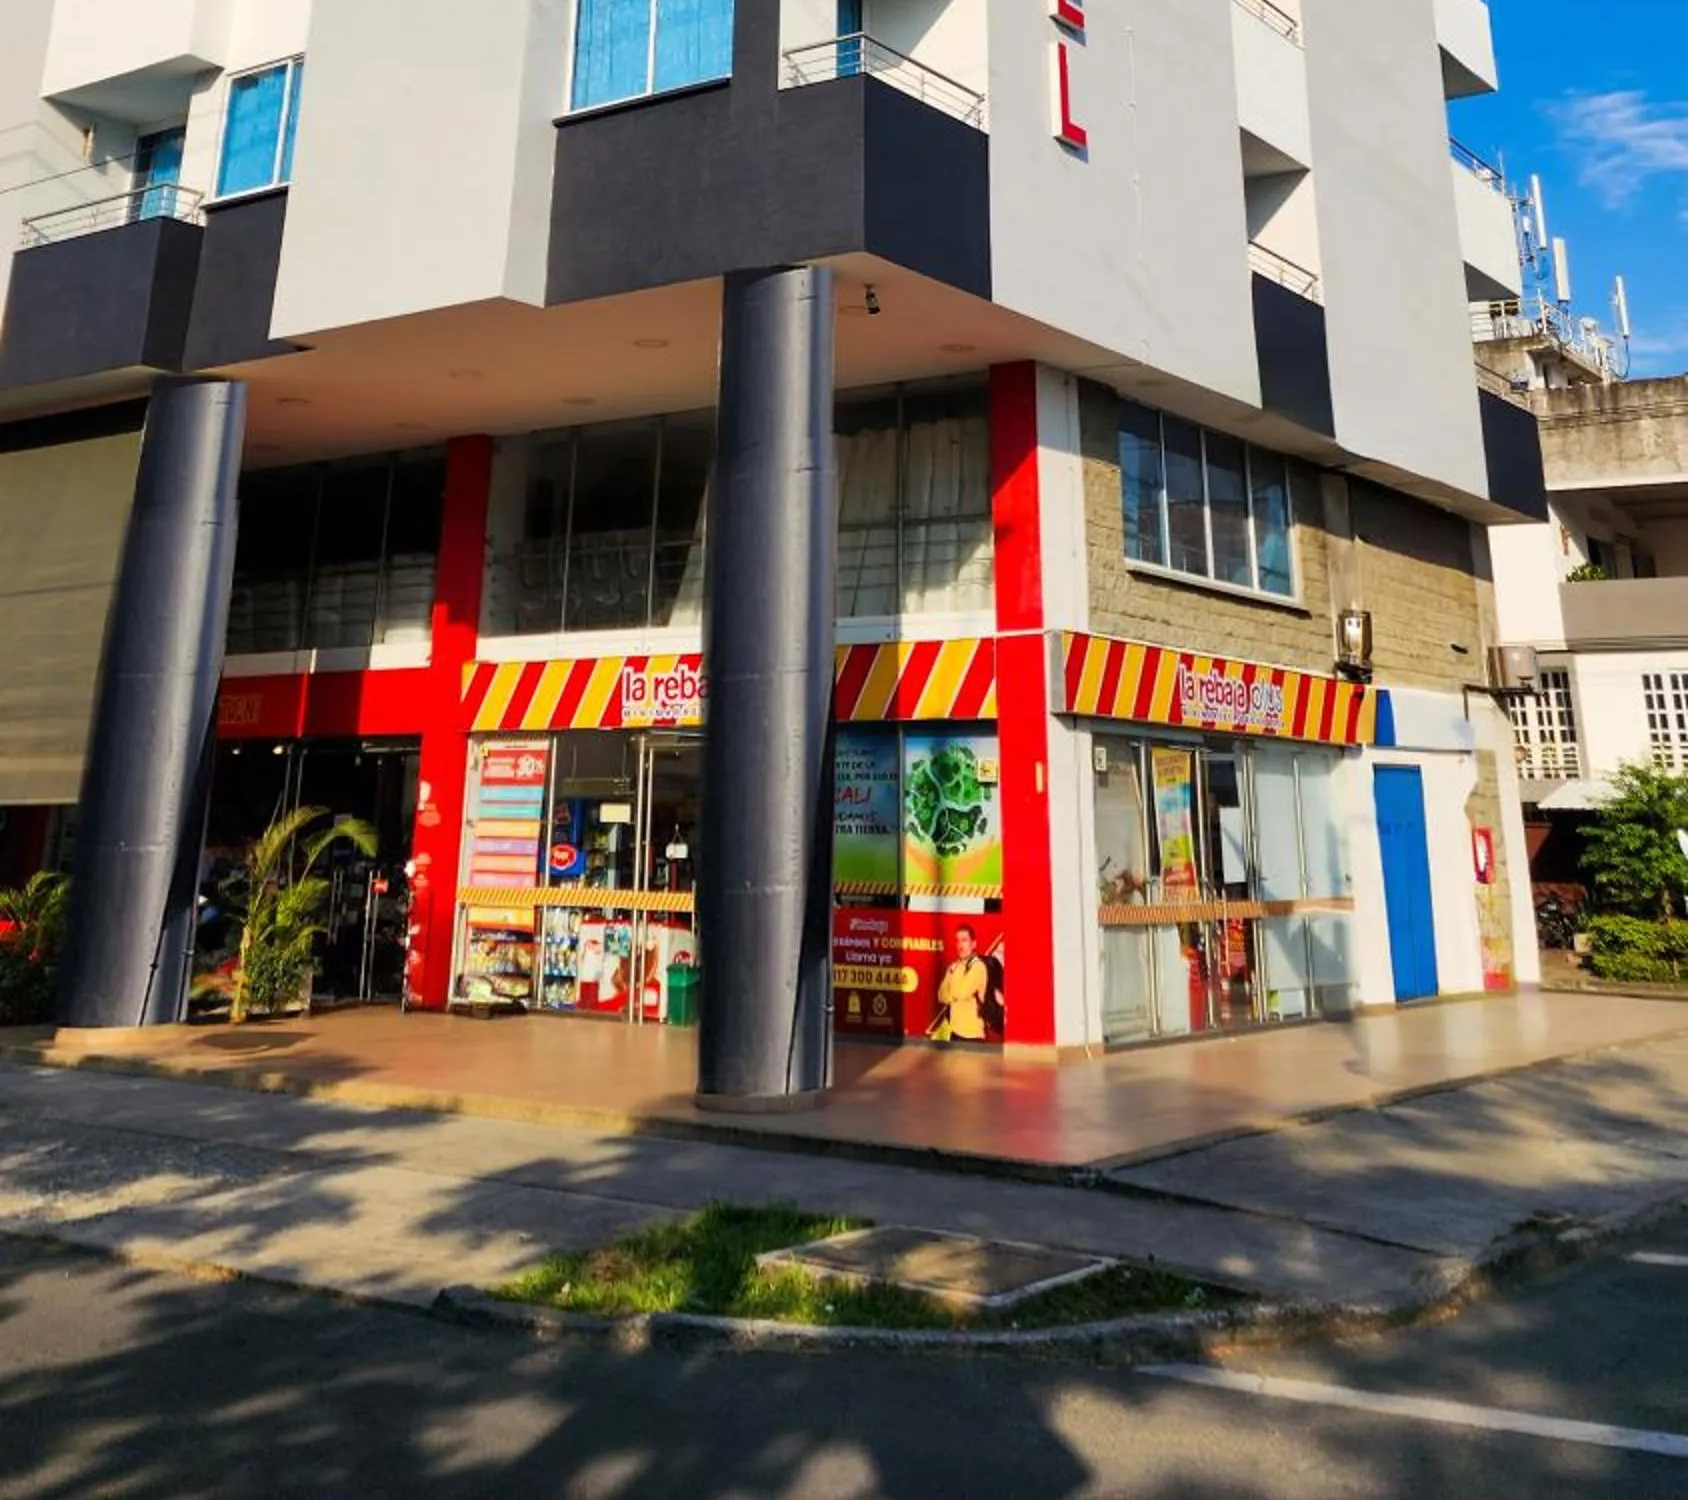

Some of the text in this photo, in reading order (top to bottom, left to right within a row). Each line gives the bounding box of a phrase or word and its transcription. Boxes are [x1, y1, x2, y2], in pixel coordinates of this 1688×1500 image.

[624, 668, 711, 701] la reba
[1180, 666, 1195, 701] la
[1199, 670, 1251, 717] rebaja
[834, 968, 848, 982] 17
